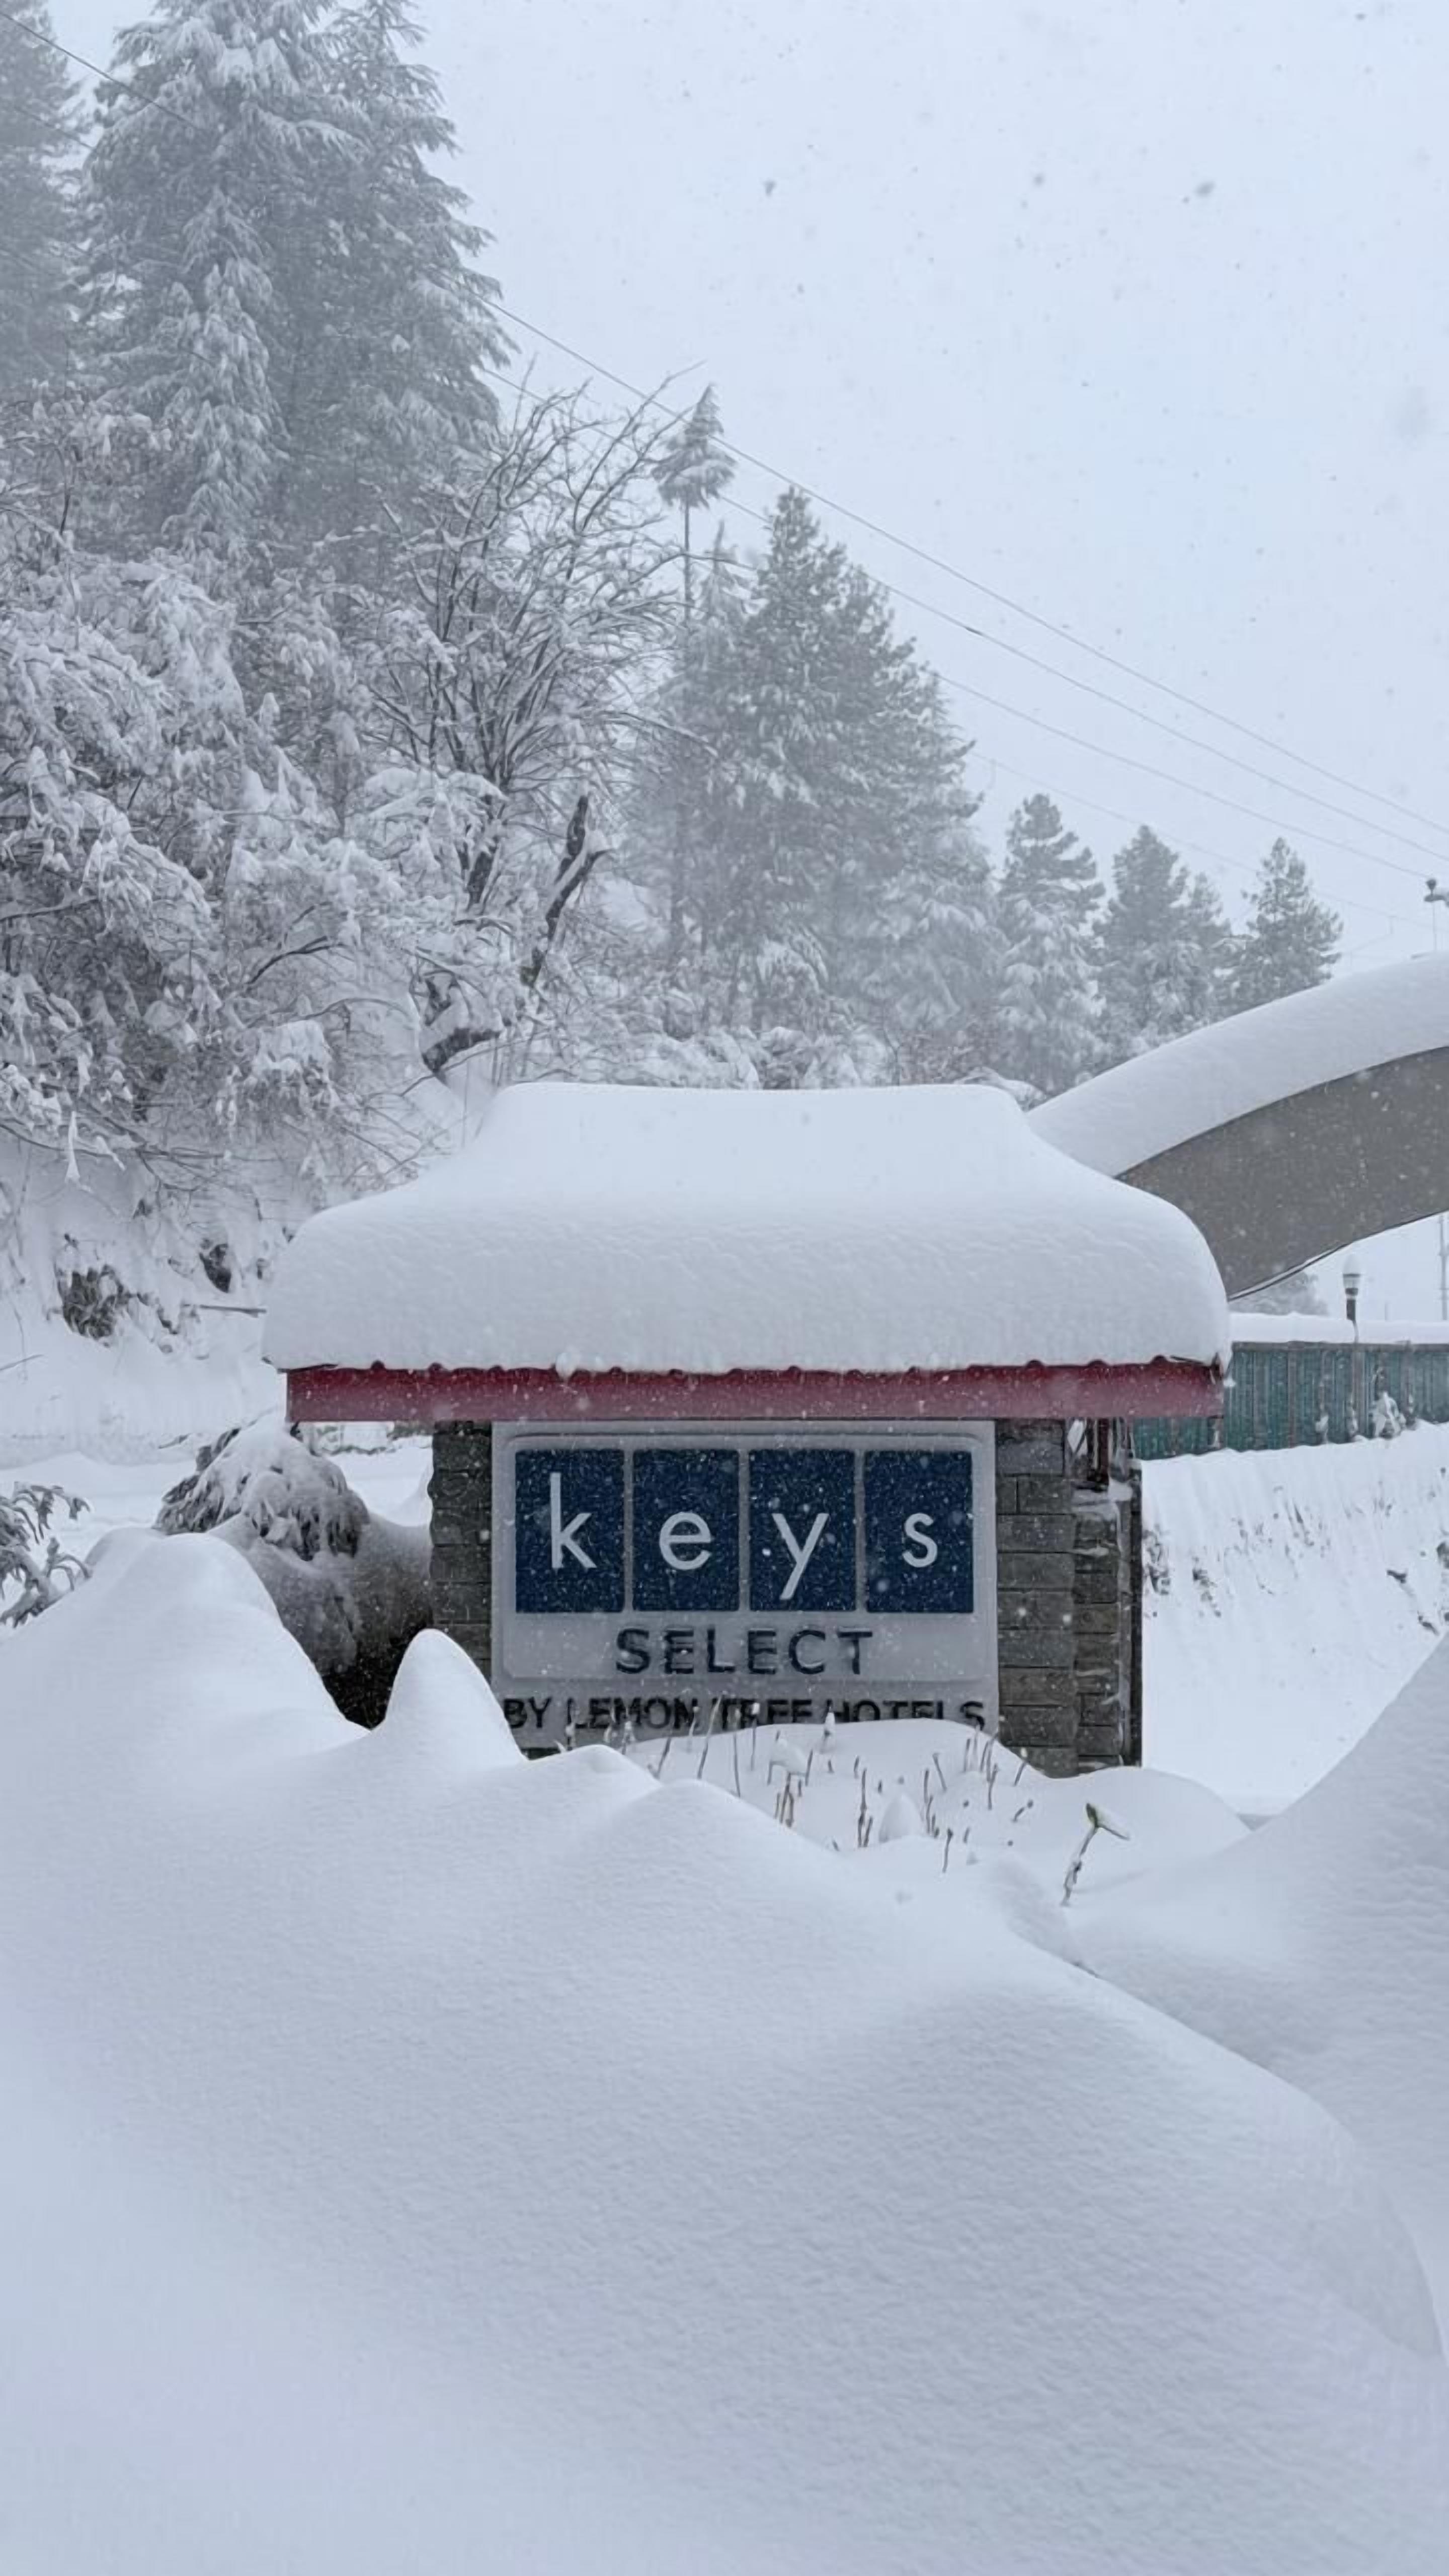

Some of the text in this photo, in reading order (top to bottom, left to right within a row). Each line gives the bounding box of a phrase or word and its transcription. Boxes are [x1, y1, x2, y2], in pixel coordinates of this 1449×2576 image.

[549, 1472, 938, 1601] keys
[616, 1627, 873, 1675] SELECT
[503, 1697, 985, 1731] BY LEMON TREE HOTELS
